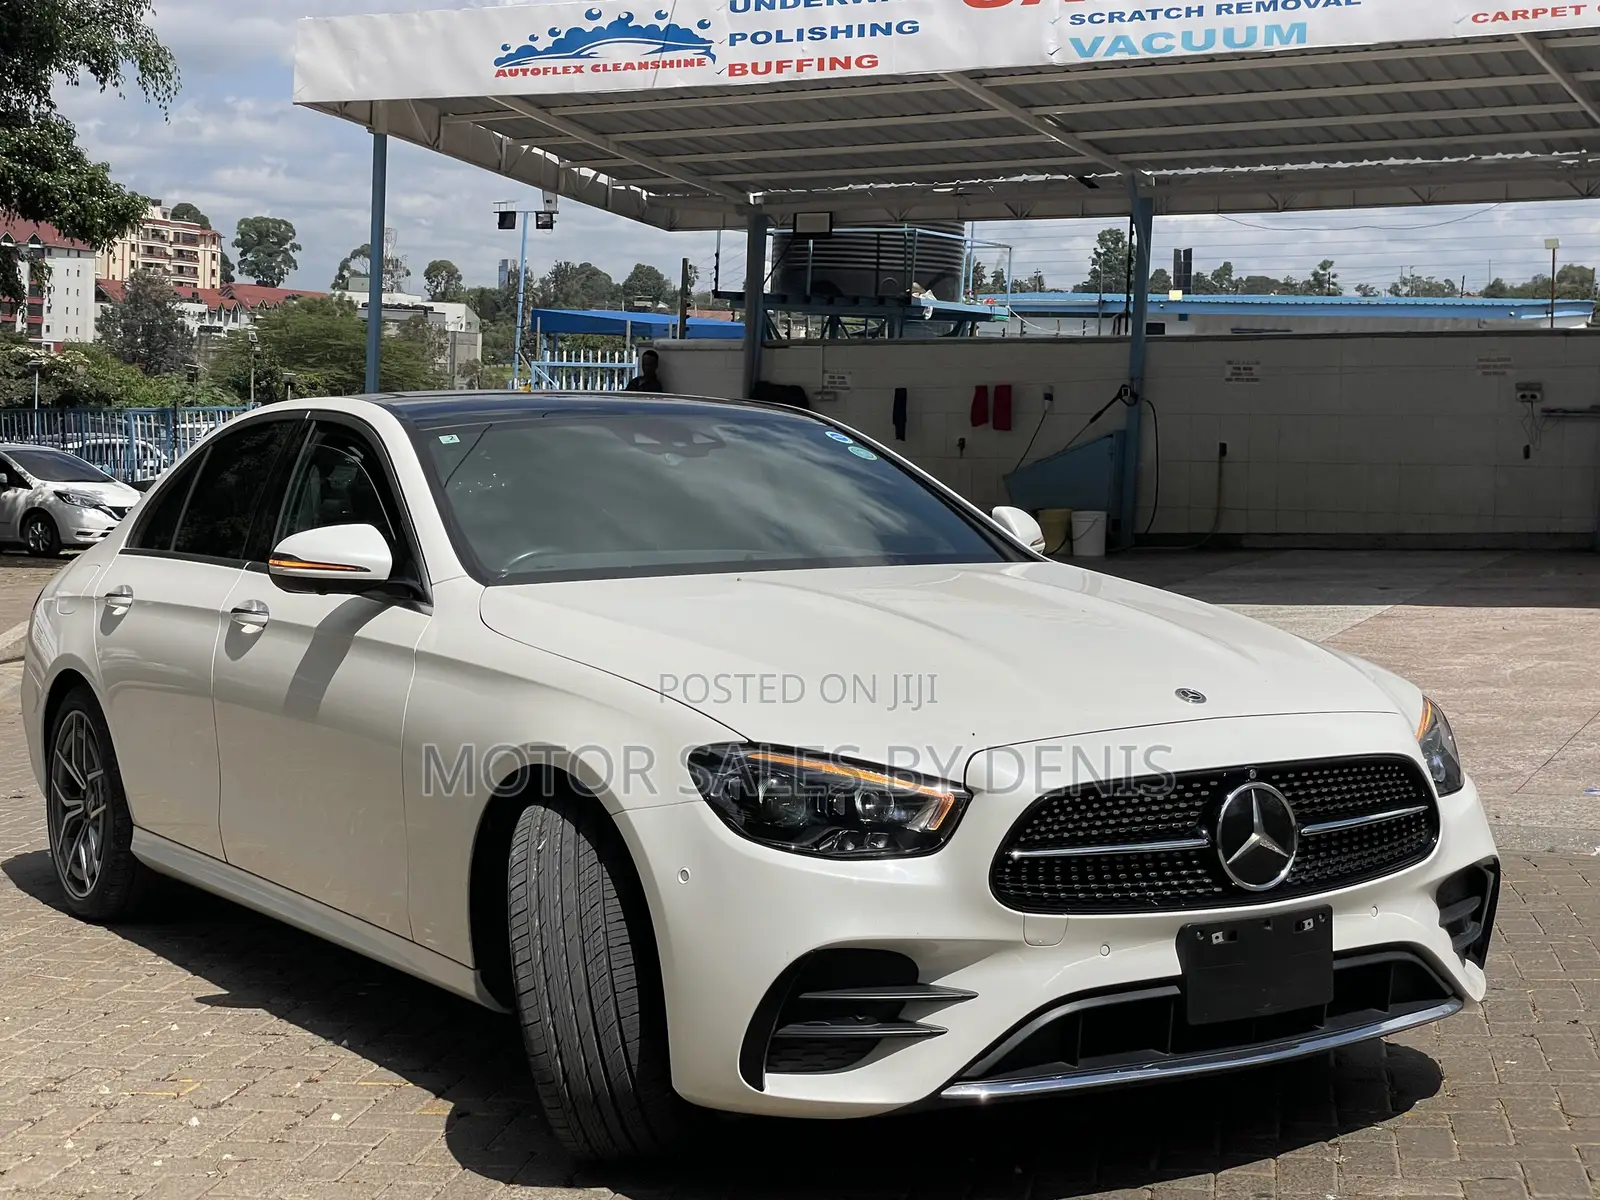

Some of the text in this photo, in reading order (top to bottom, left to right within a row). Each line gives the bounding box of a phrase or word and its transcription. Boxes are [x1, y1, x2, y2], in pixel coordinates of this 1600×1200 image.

[1069, 5, 1204, 26] SCRATCH
[1471, 4, 1588, 24] CARPET
[728, 19, 920, 47] POLISHING
[1069, 21, 1308, 58] VACUUM
[494, 57, 707, 78] AUTOFLEX CLEANSHINE
[728, 54, 880, 77] BUFFING
